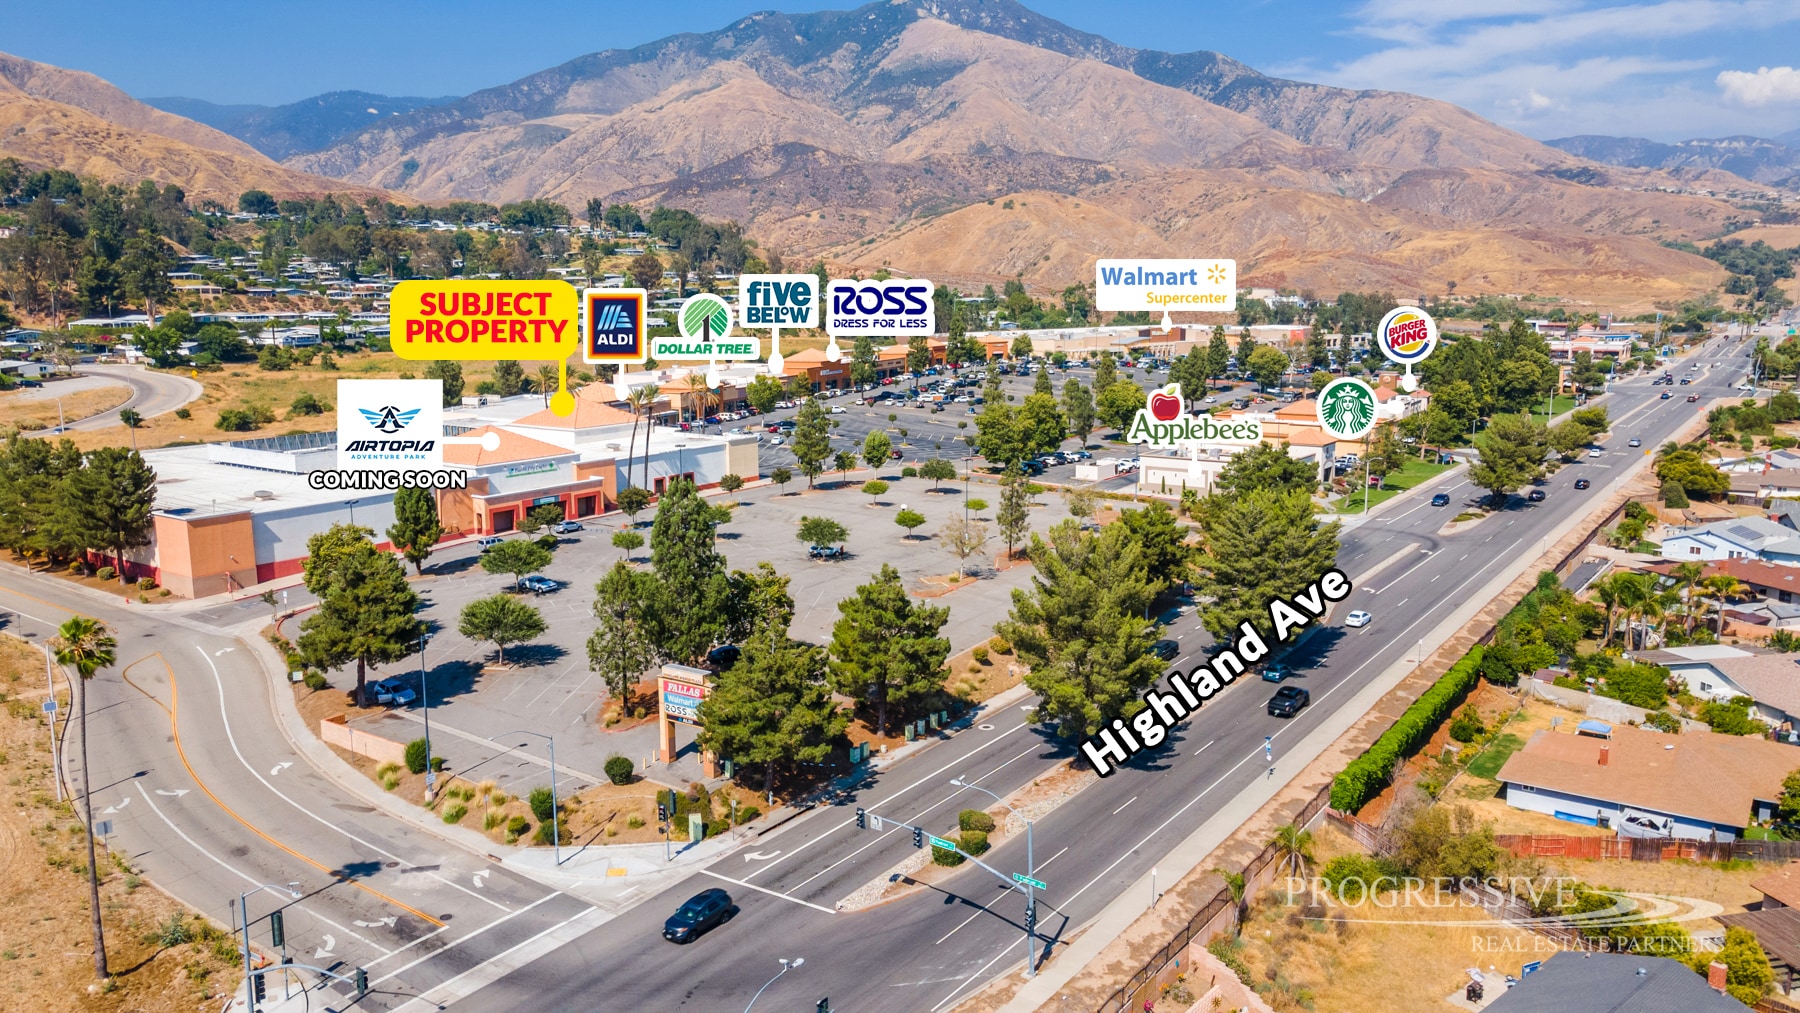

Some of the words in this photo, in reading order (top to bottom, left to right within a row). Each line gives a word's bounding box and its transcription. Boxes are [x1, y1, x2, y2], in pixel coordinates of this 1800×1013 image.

[667, 683, 701, 697] FALLAS
[667, 693, 693, 707] Walmart
[665, 704, 688, 716] ROSS
